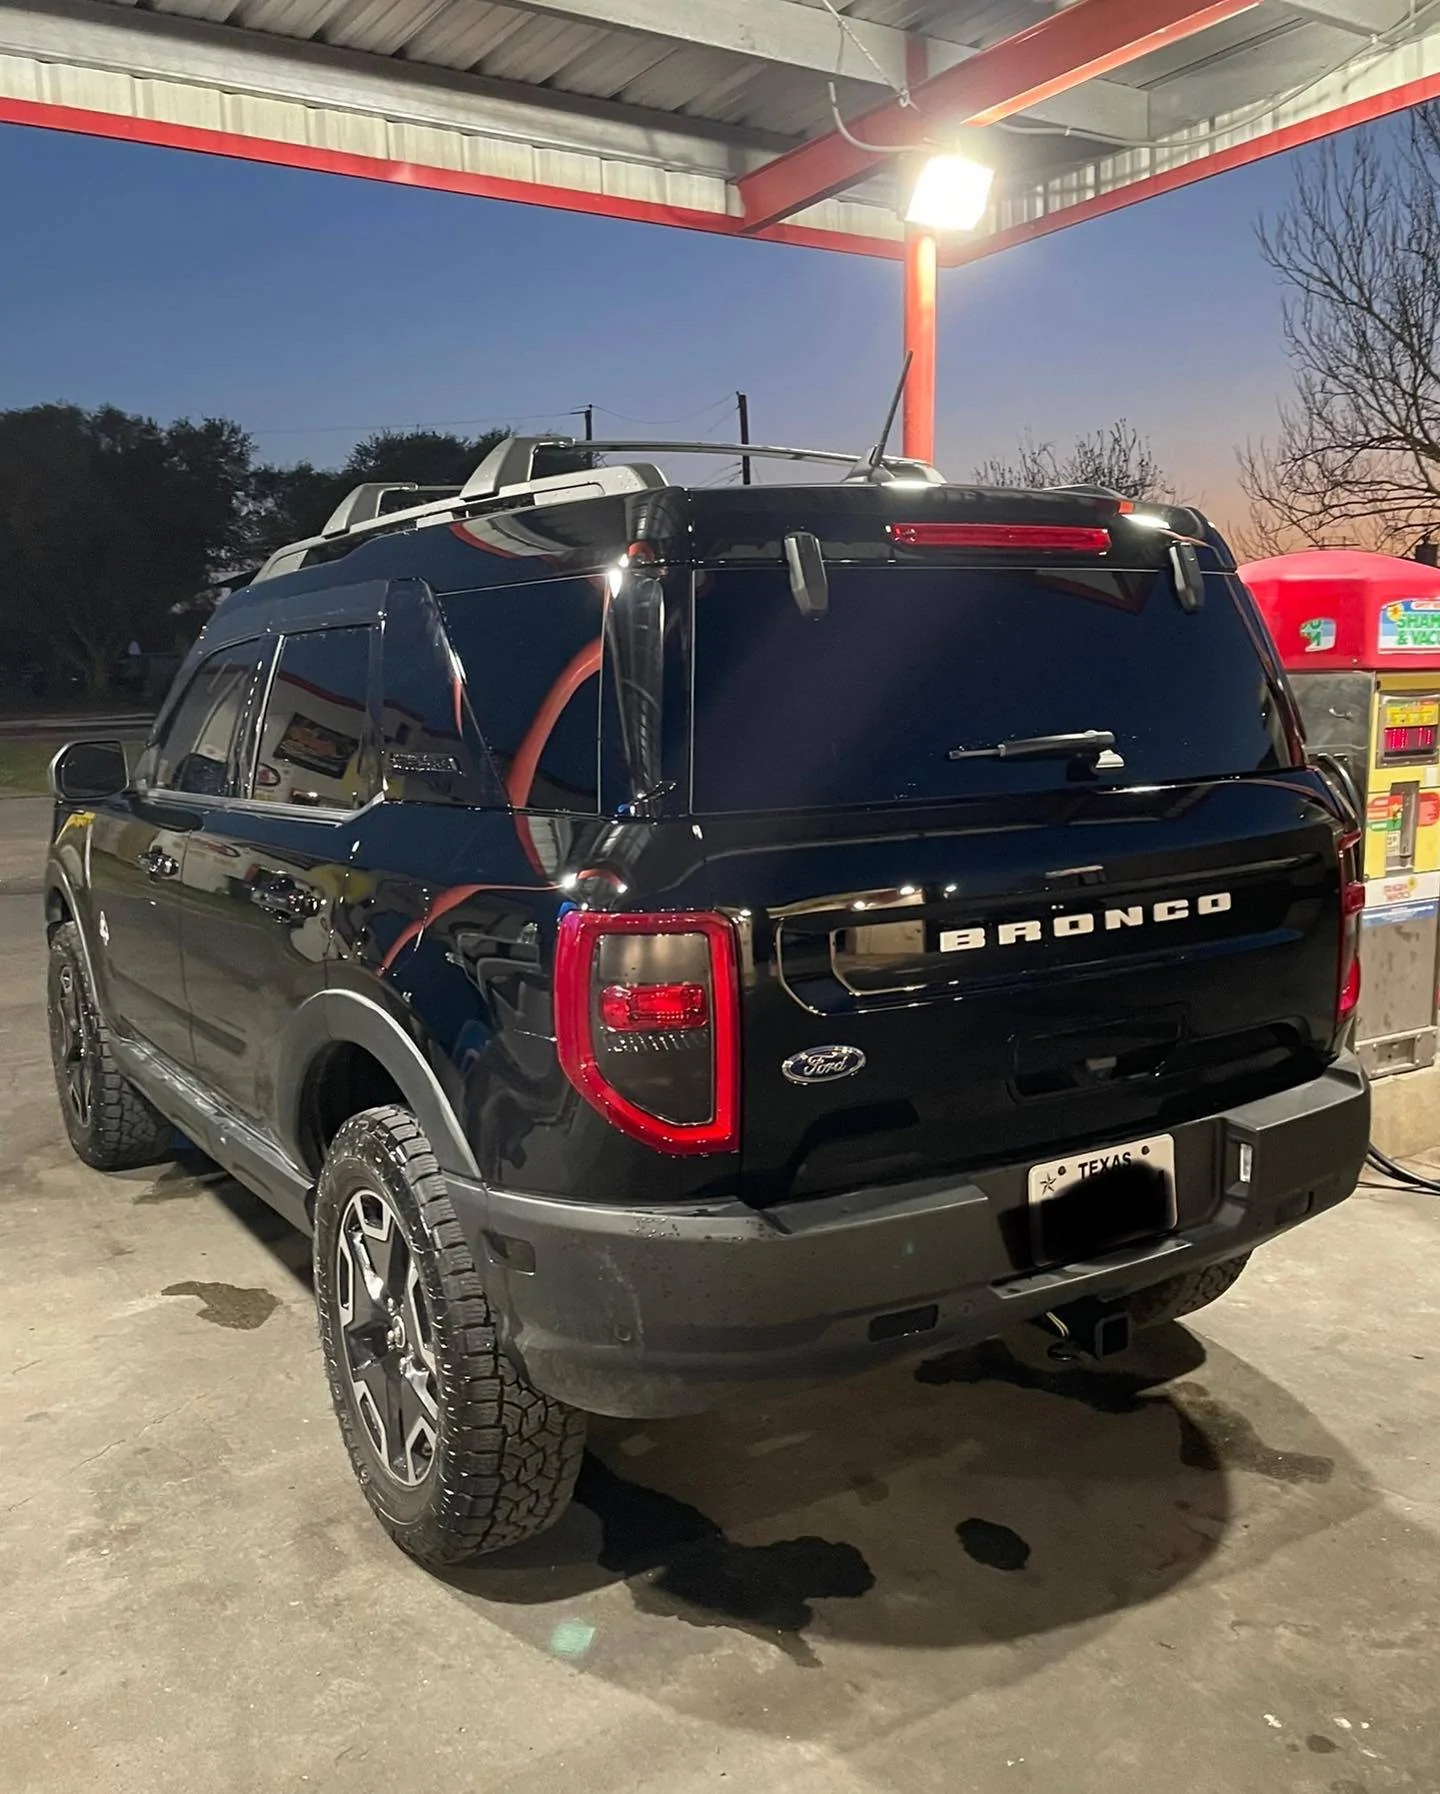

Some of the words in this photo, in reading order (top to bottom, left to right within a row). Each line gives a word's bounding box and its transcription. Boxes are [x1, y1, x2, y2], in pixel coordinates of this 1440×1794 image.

[940, 892, 1231, 953] BRONCO
[804, 1051, 849, 1074] Ford
[1077, 1152, 1132, 1180] TEXAS
